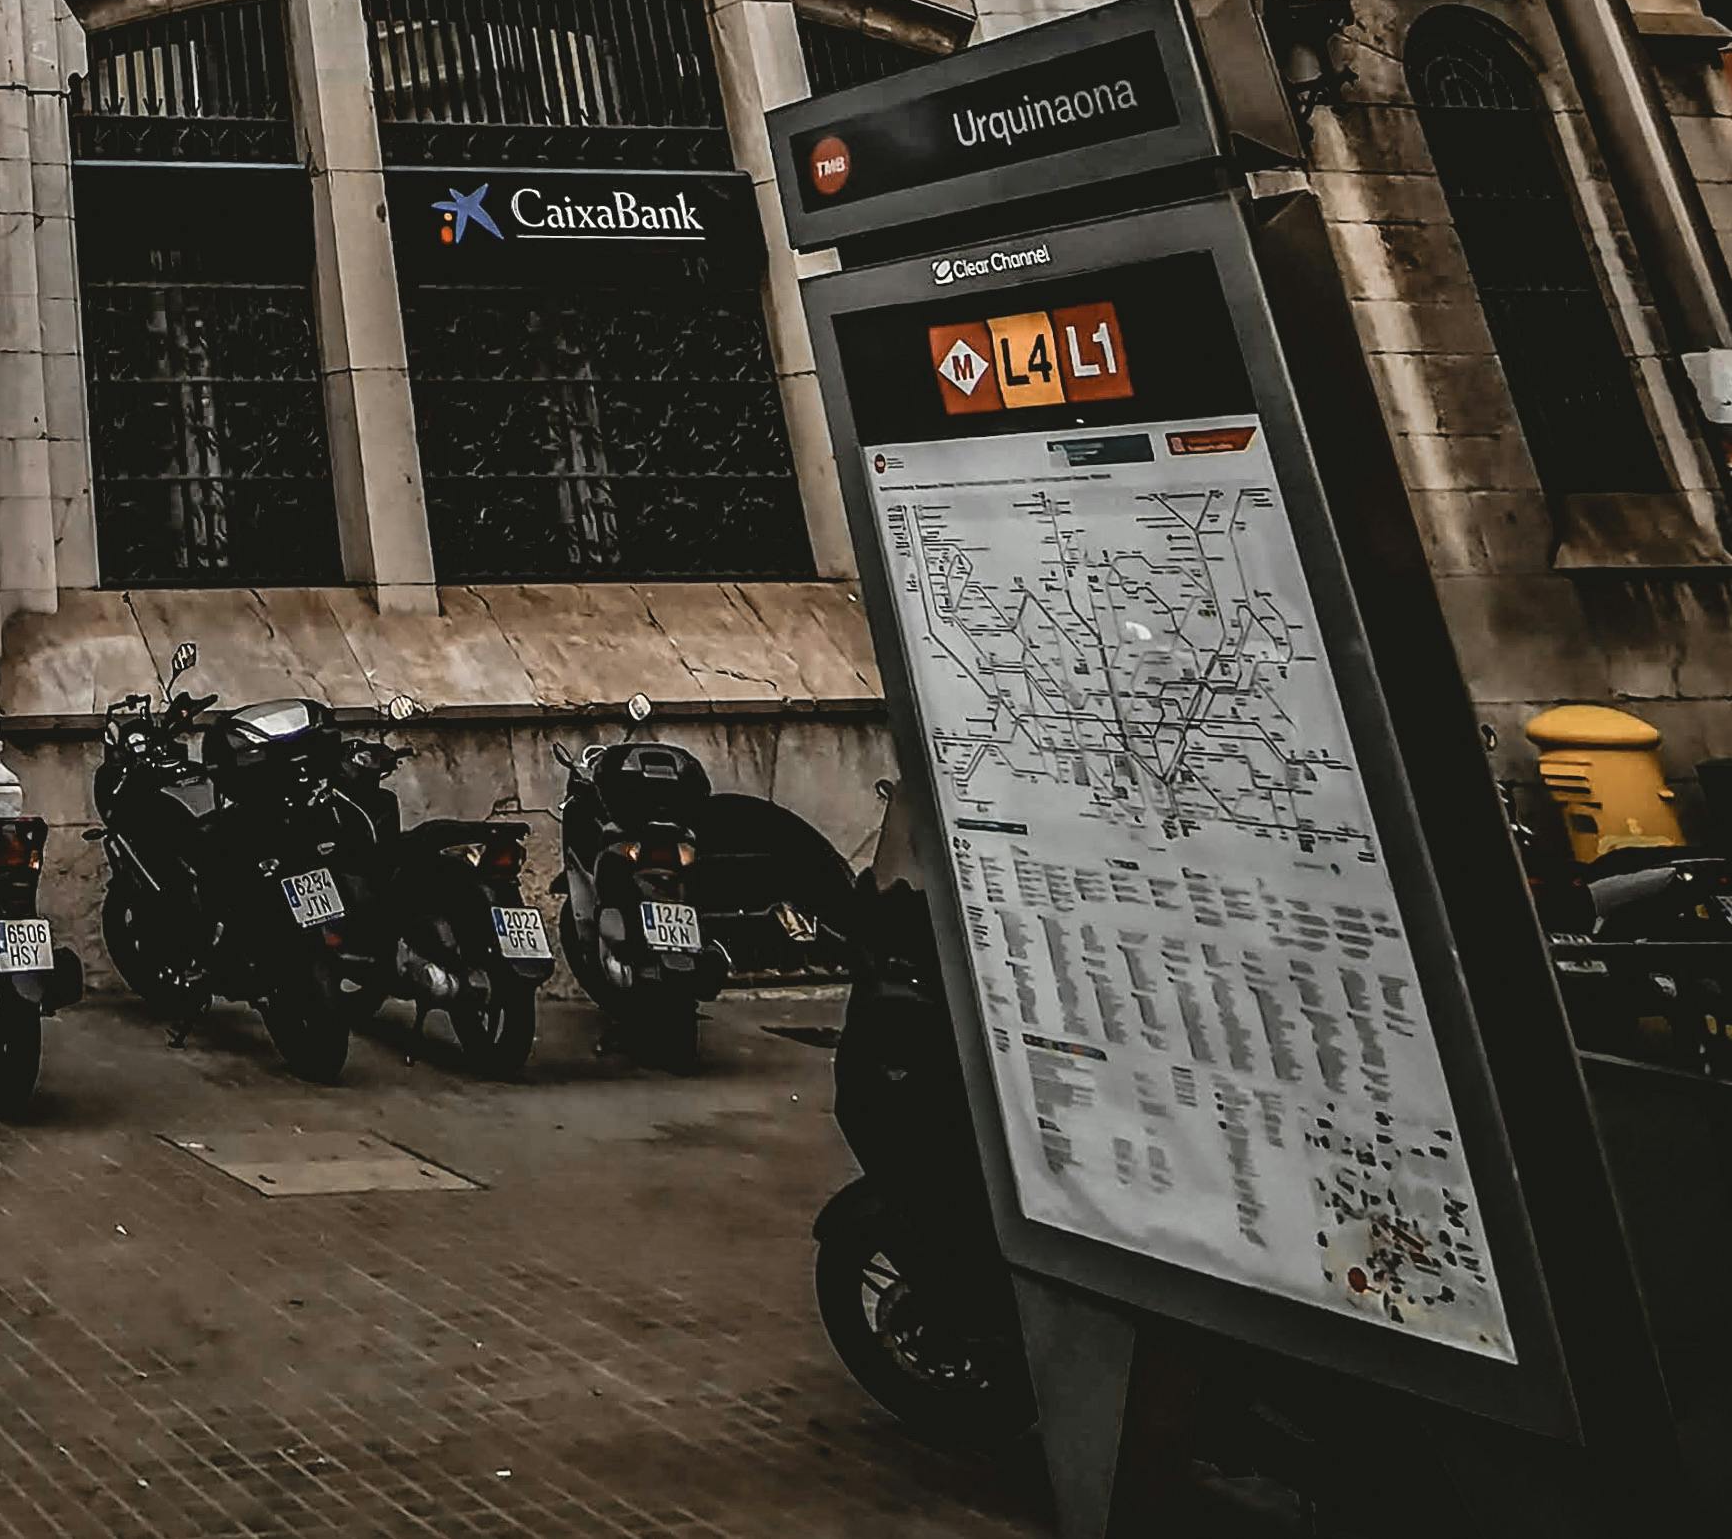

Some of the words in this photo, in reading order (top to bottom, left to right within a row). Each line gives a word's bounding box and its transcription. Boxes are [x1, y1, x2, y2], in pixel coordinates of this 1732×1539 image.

[952, 79, 1138, 146] Urquinaona
[816, 156, 846, 178] TMB
[510, 187, 705, 230] CaixaBank
[953, 259, 990, 278] Clear
[990, 244, 1051, 271] Channel
[951, 353, 975, 381] M
[1000, 333, 1053, 387] L4
[1066, 322, 1117, 377] L1
[306, 893, 333, 917] JTN
[655, 905, 695, 926] 1242
[504, 910, 540, 930] 2022
[7, 923, 47, 944] 6506
[508, 930, 537, 949] GFG
[657, 924, 691, 945] DKN
[10, 944, 39, 966] HSY
